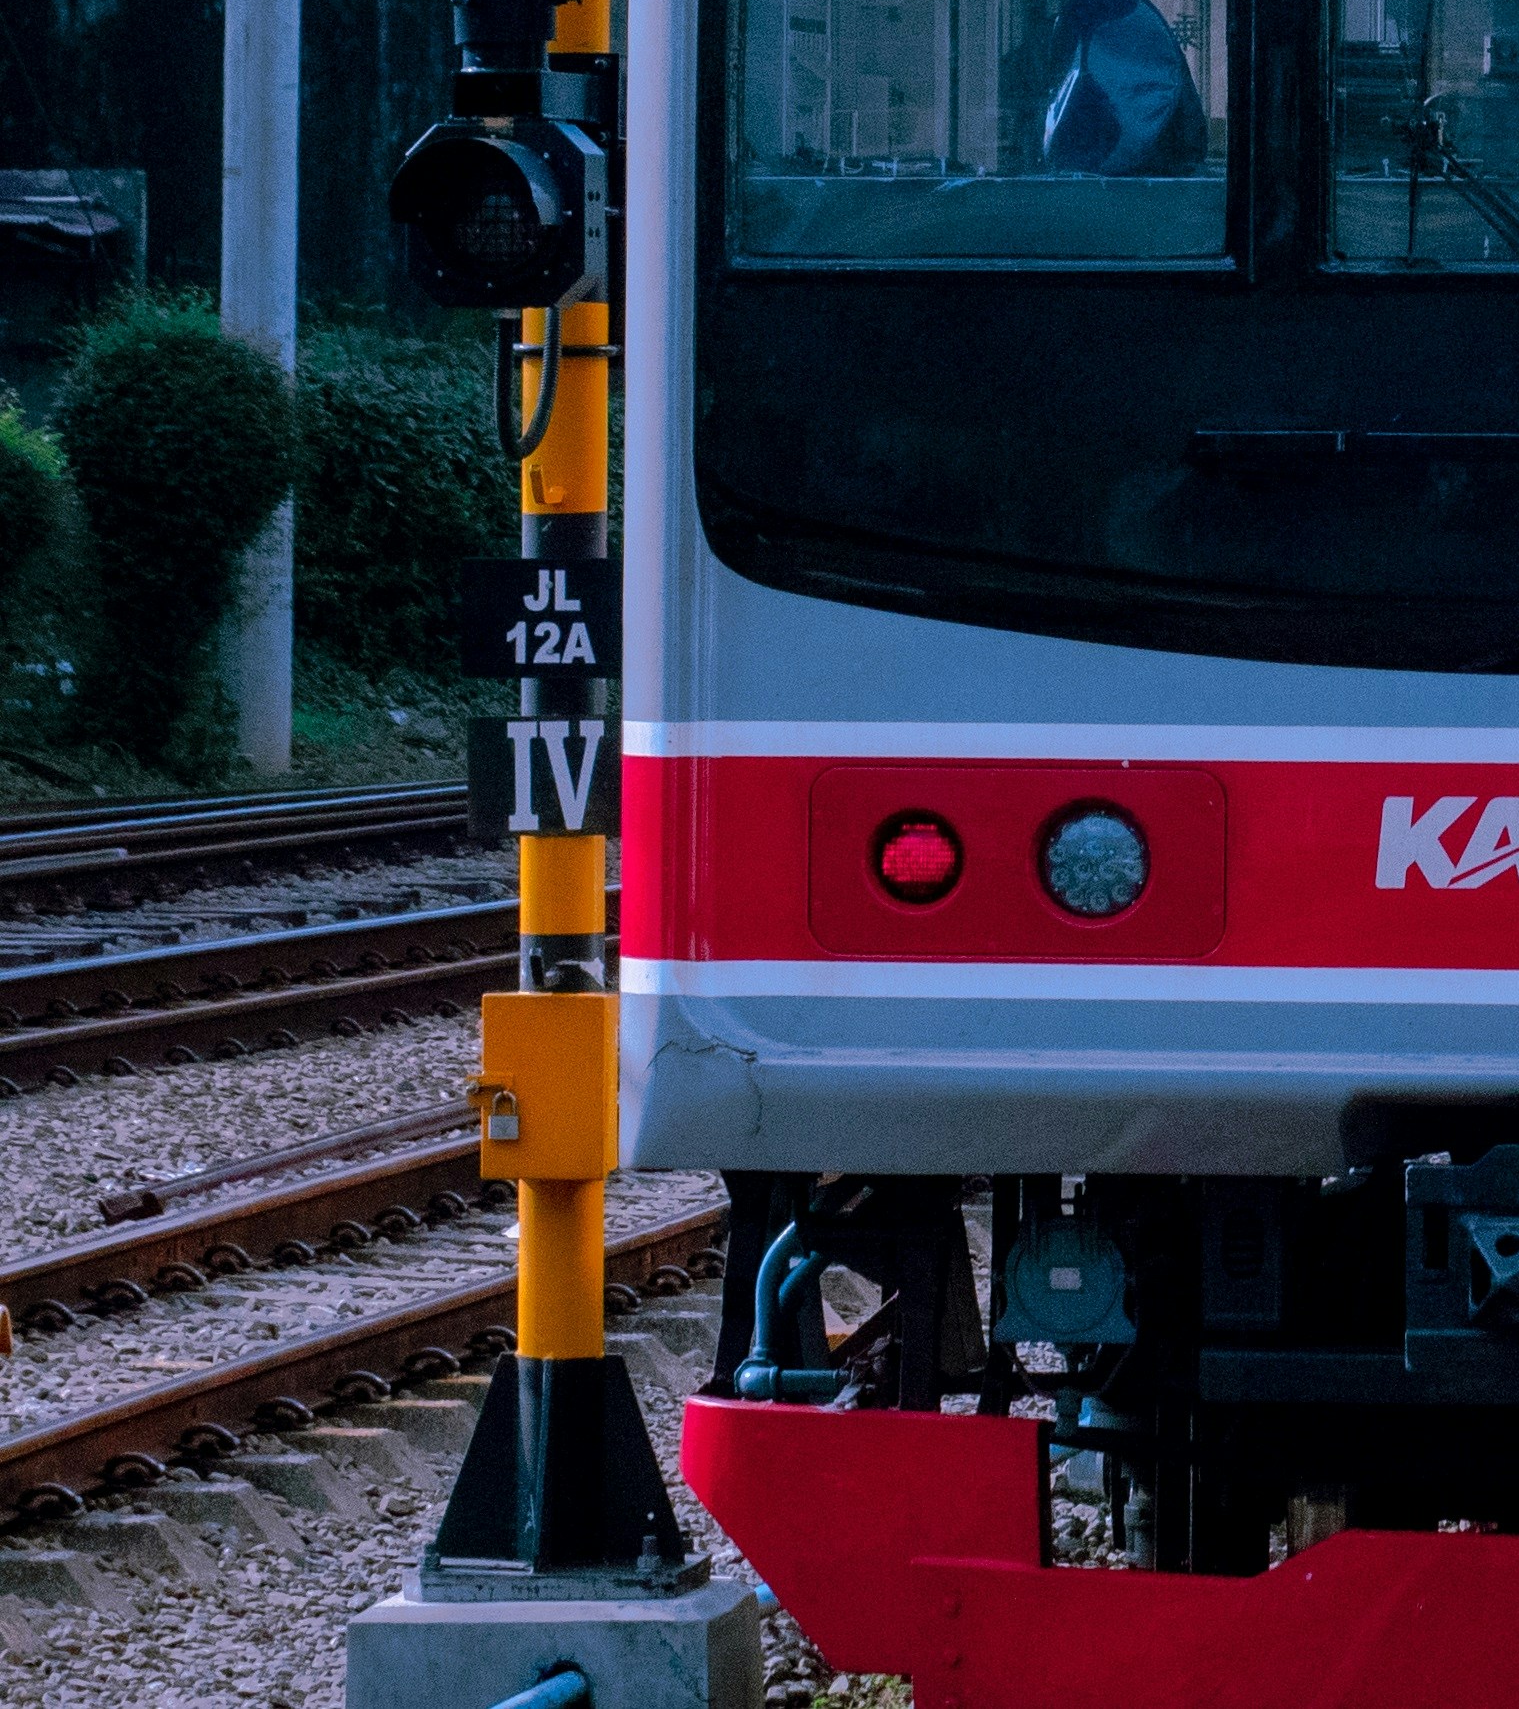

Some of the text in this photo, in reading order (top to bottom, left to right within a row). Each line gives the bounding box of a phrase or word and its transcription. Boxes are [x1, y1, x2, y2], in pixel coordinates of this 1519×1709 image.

[523, 569, 581, 612] JL
[506, 621, 596, 665] 12A
[507, 720, 605, 831] IV
